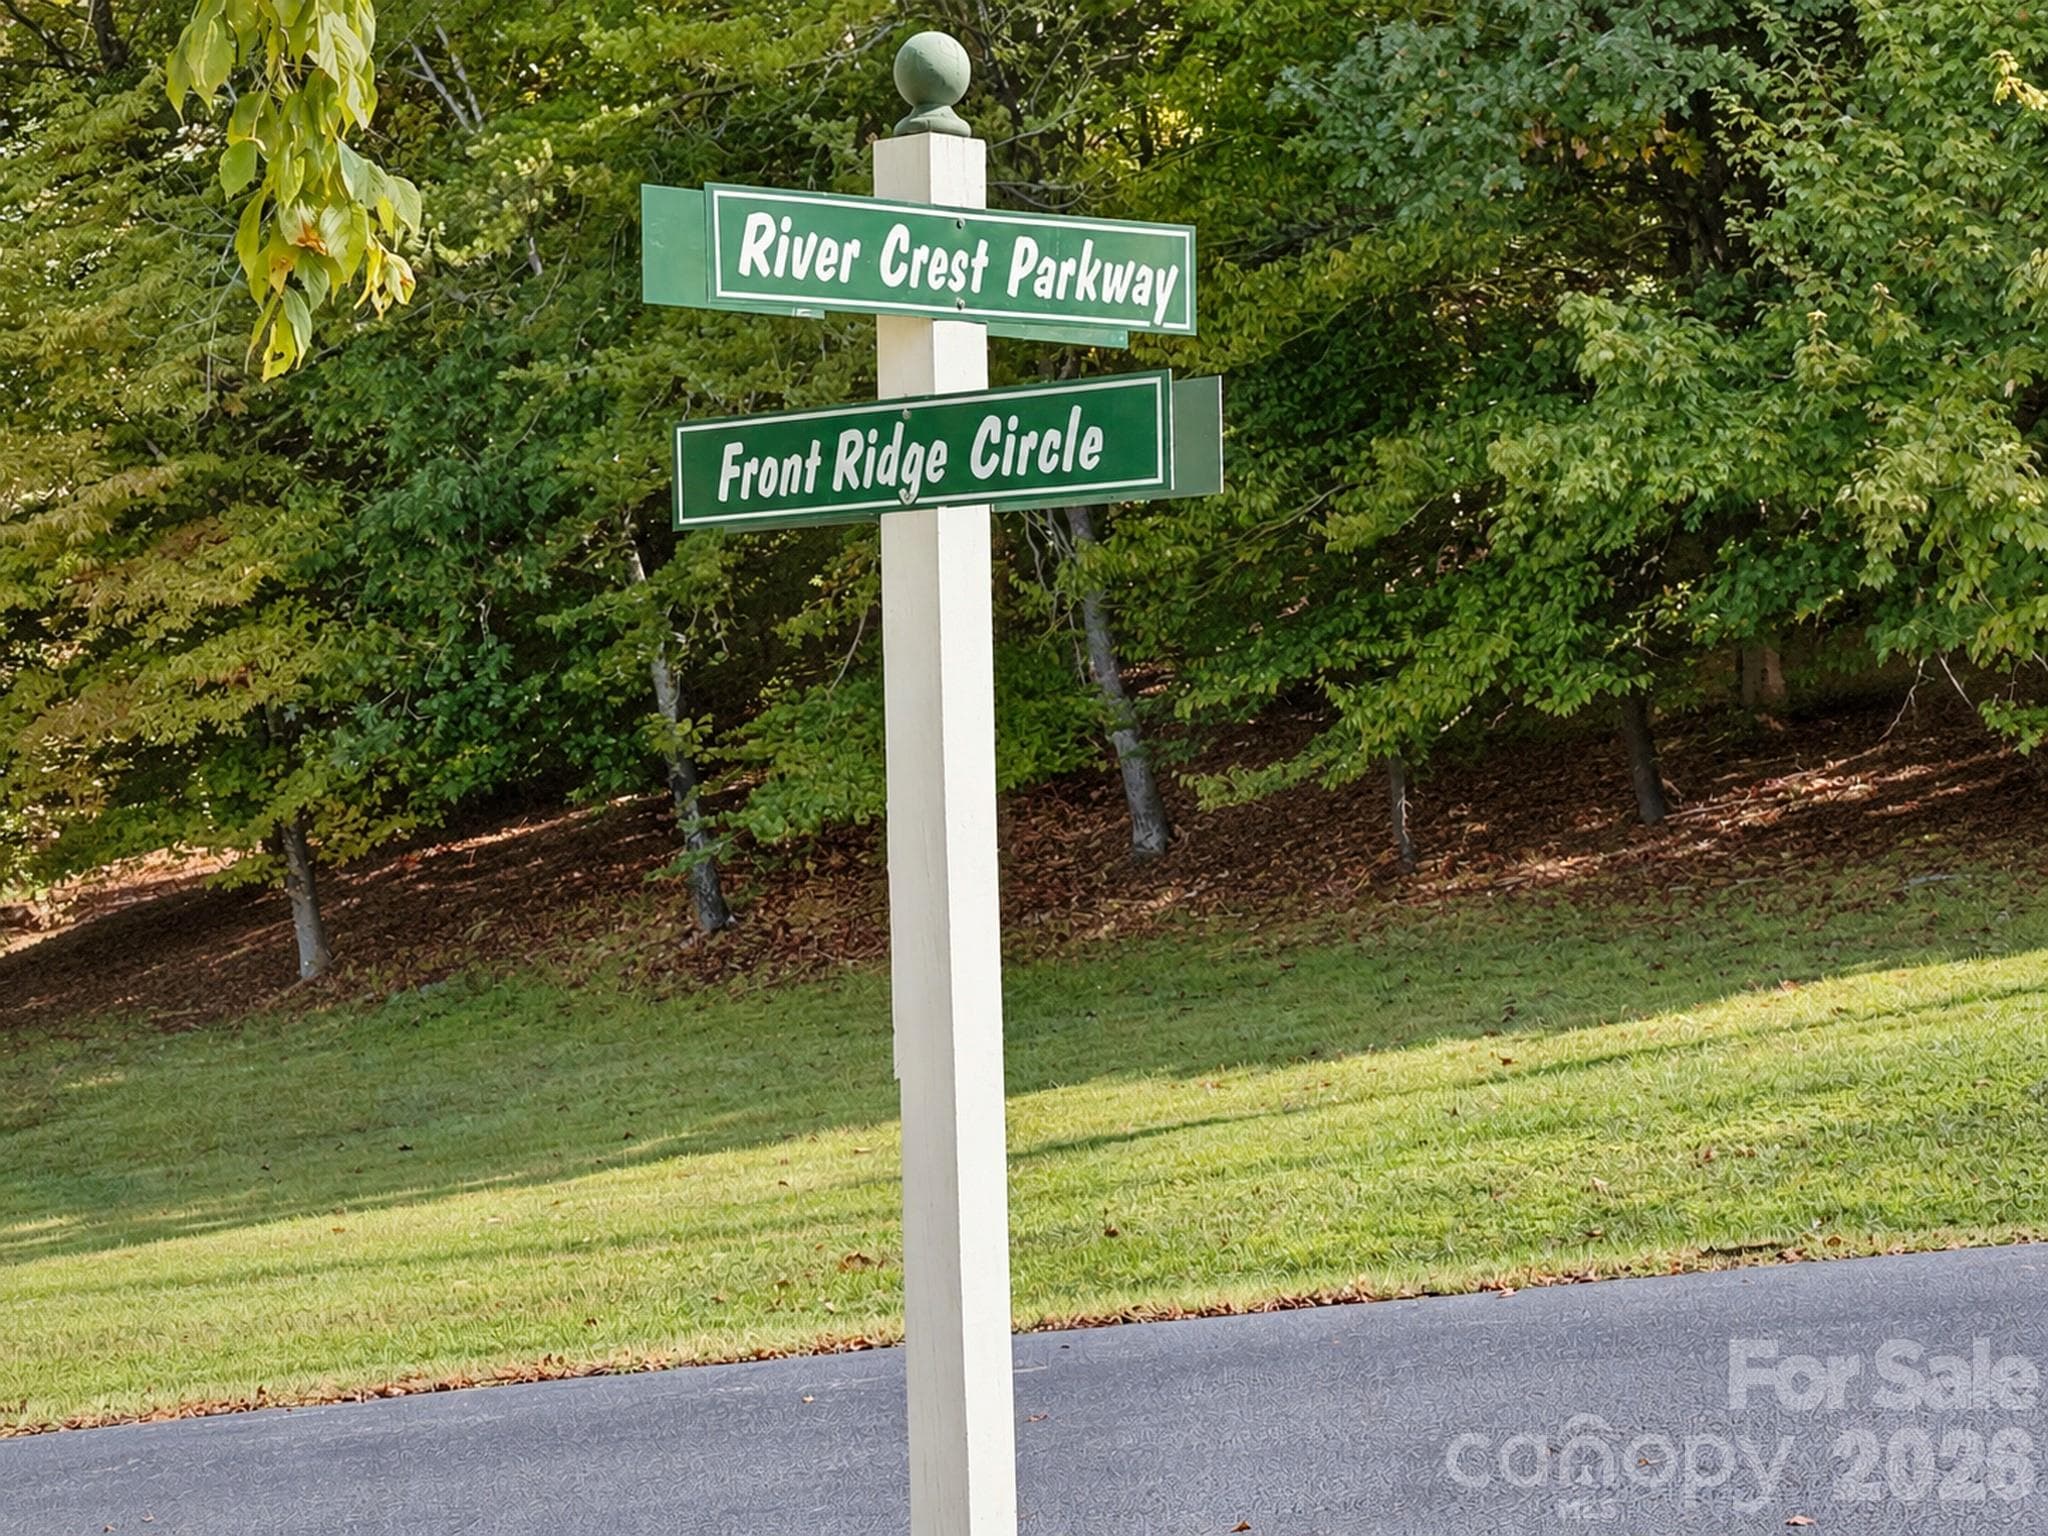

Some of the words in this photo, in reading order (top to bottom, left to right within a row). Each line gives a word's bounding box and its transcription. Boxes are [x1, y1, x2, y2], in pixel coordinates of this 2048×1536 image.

[737, 211, 862, 284] River
[879, 222, 990, 295] Crest
[1006, 235, 1180, 327] Parkway
[717, 440, 822, 503] Front
[832, 421, 948, 506] Ridge
[970, 404, 1104, 480] Circle
